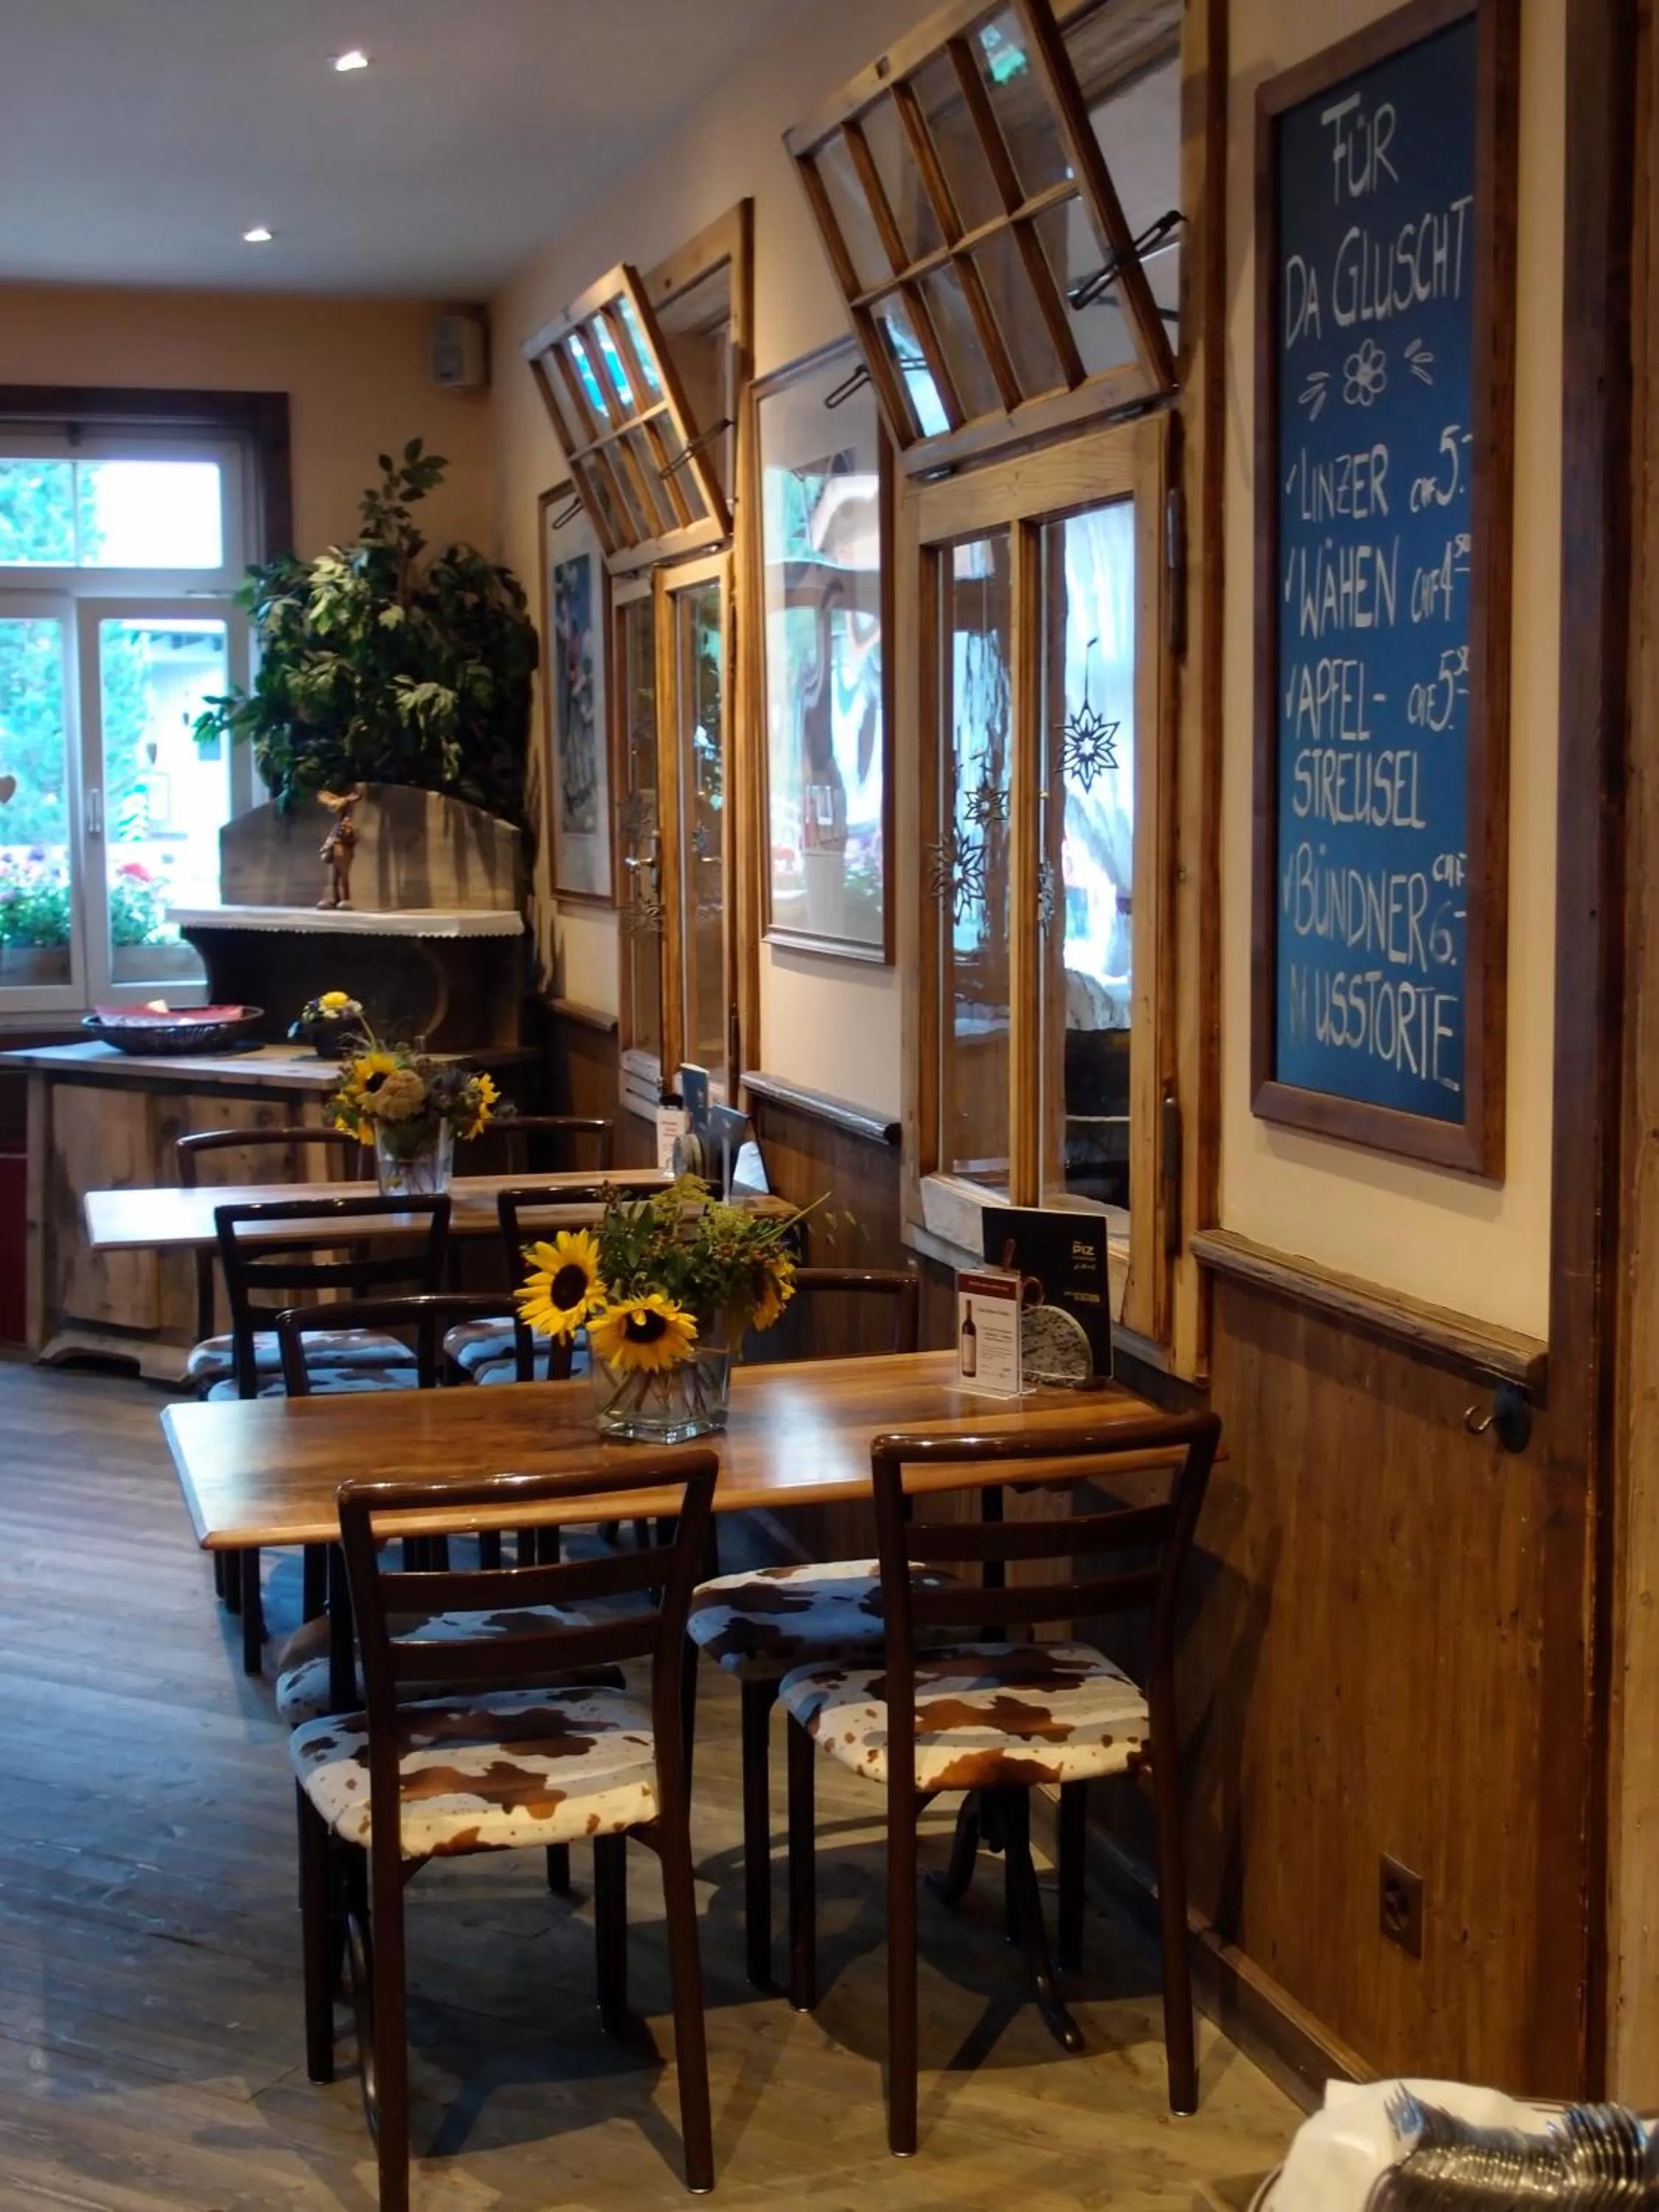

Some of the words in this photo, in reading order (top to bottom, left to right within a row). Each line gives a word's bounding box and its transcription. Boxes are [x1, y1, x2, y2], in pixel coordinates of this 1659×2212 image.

[1321, 91, 1399, 206] FÜR
[1285, 254, 1321, 351] DA
[1332, 195, 1473, 327] GLUSCHT
[1301, 444, 1389, 522] LINZER
[1293, 748, 1425, 829] STREUSEL
[1294, 842, 1427, 973] BÜNDNER
